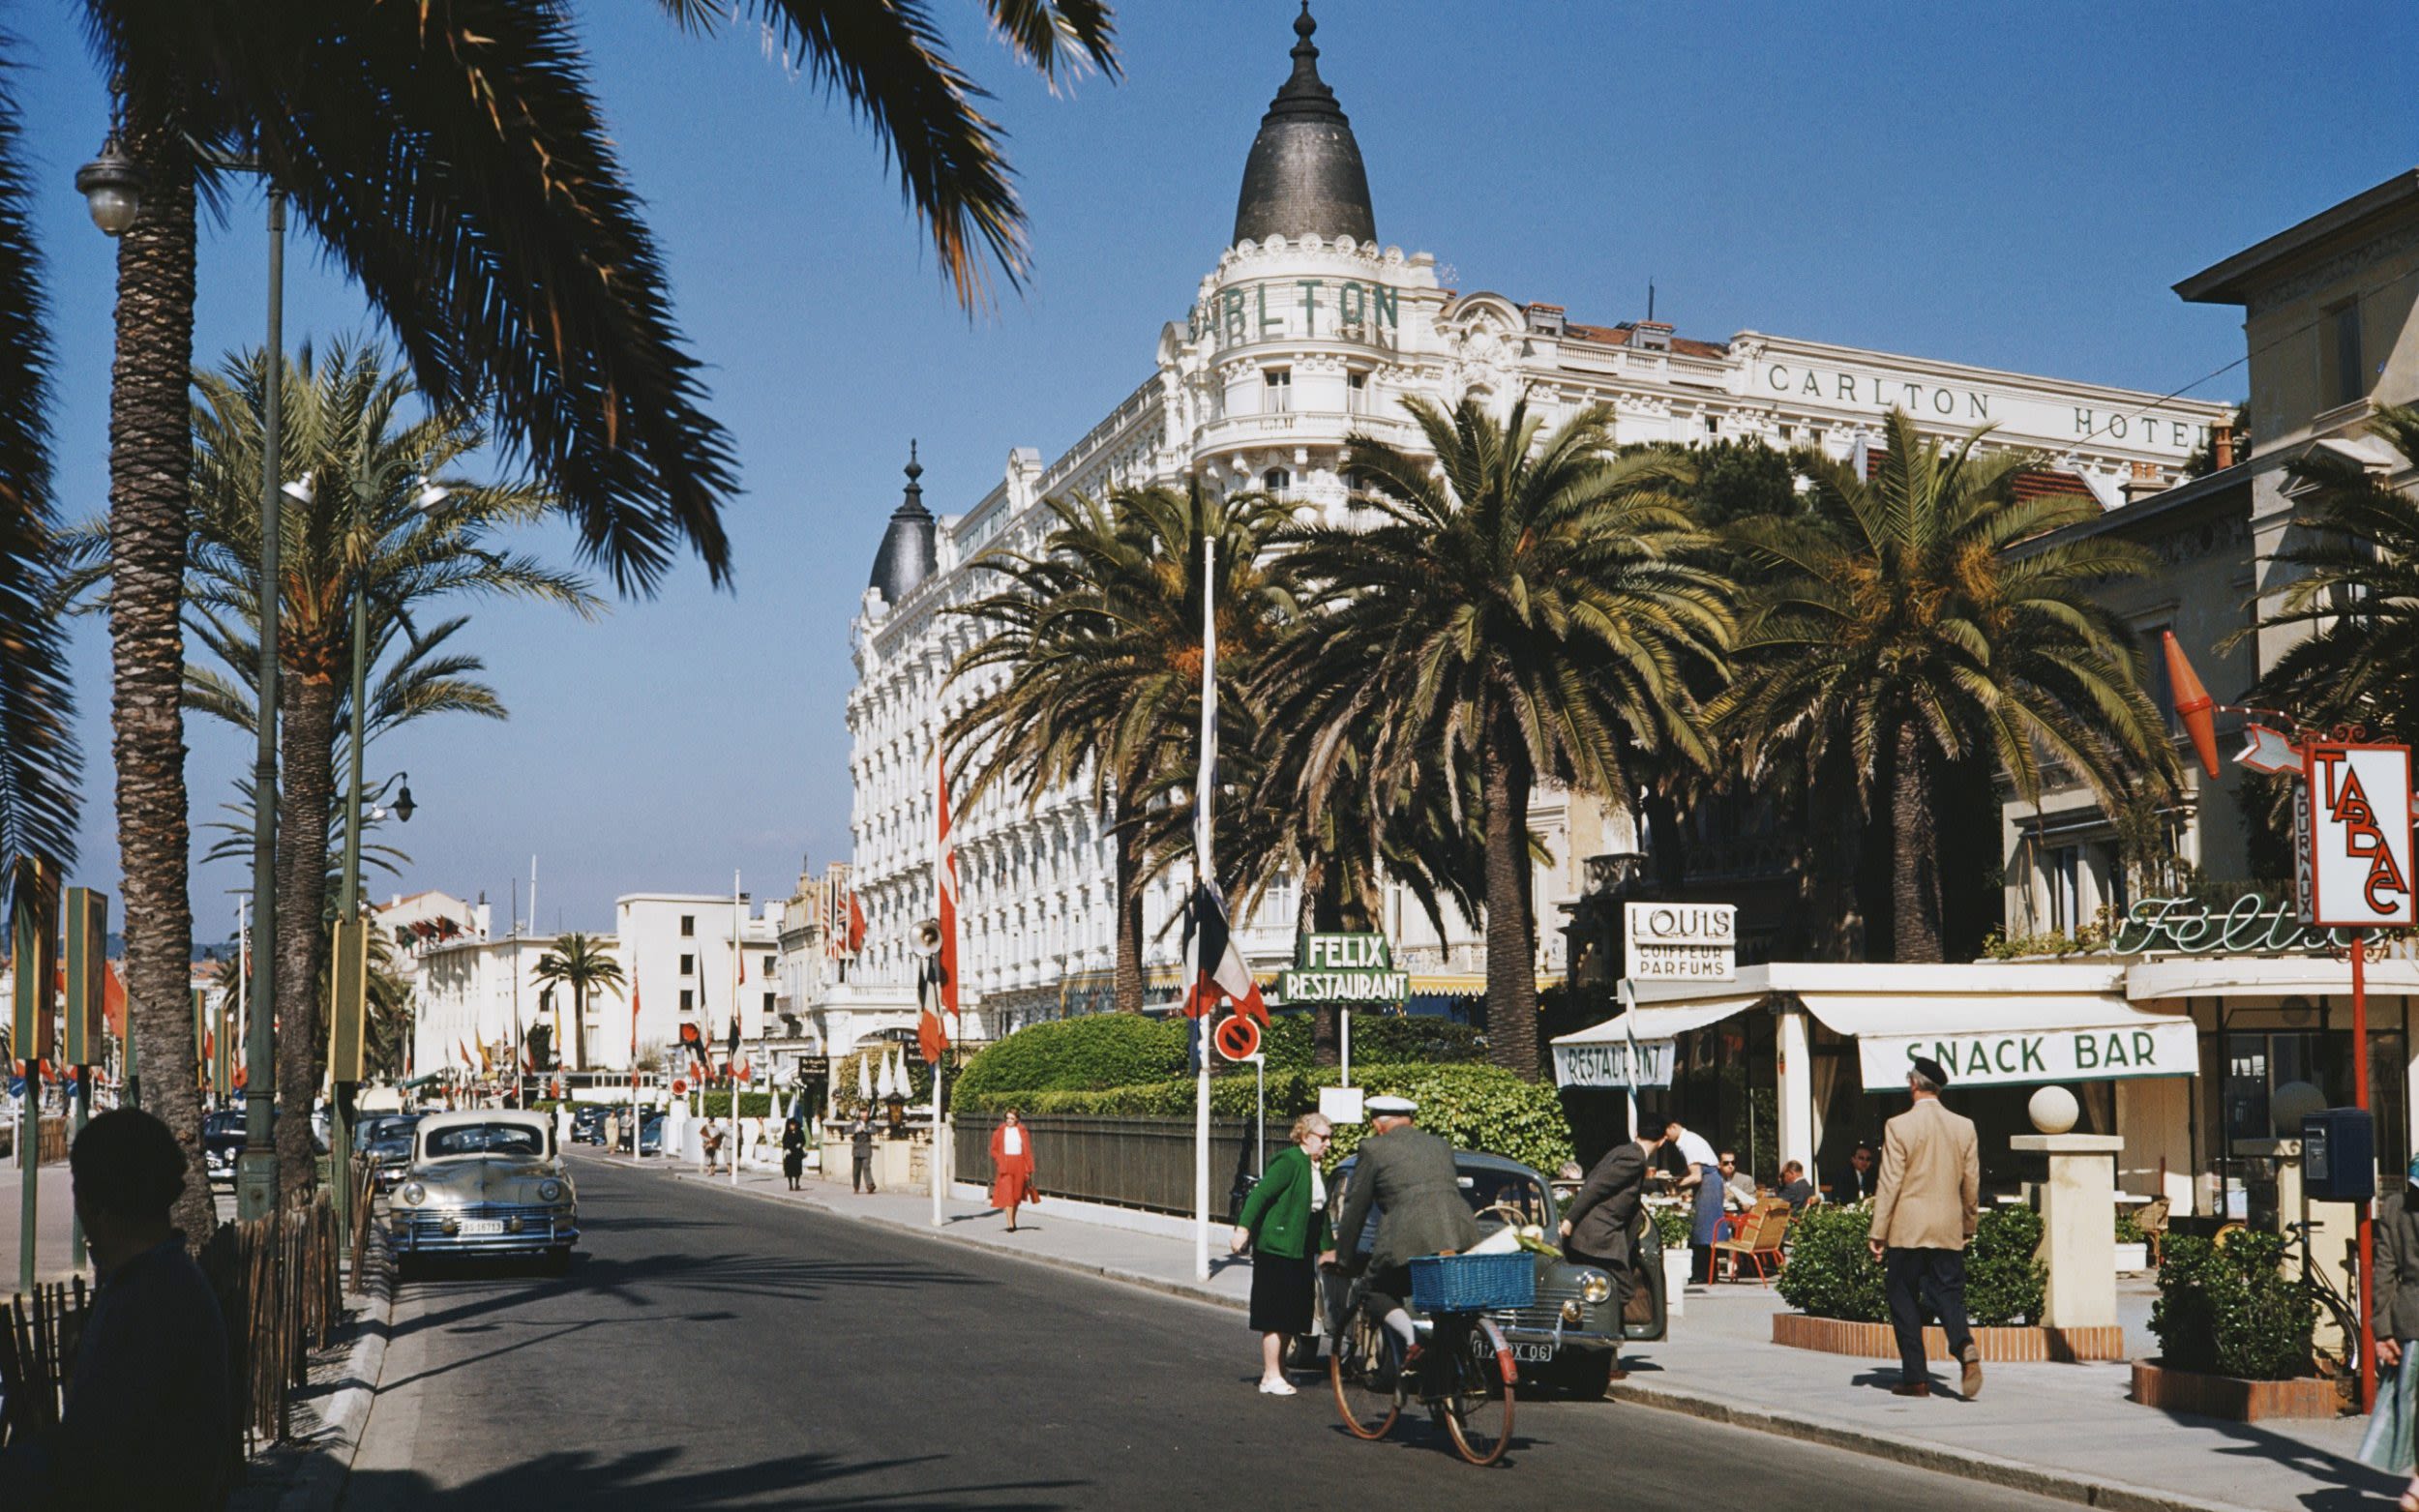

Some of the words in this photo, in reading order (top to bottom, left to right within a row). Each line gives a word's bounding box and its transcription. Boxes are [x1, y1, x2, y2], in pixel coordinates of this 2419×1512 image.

[1186, 280, 1398, 345] CARLTON
[1769, 365, 1988, 419] CARLTON
[2314, 750, 2409, 915] TABAC
[2298, 785, 2313, 916] JOURNAUX
[1632, 908, 1730, 937] LOUIS
[1309, 935, 1385, 968] FELIX
[1640, 945, 1722, 960] COIFFEUR
[1640, 962, 1724, 976] PARFUMS
[1286, 973, 1408, 1001] RESTAURANT
[1906, 1037, 2047, 1077] SNACK
[2075, 1031, 2157, 1070] BAR
[1529, 1346, 1548, 1360] 06
